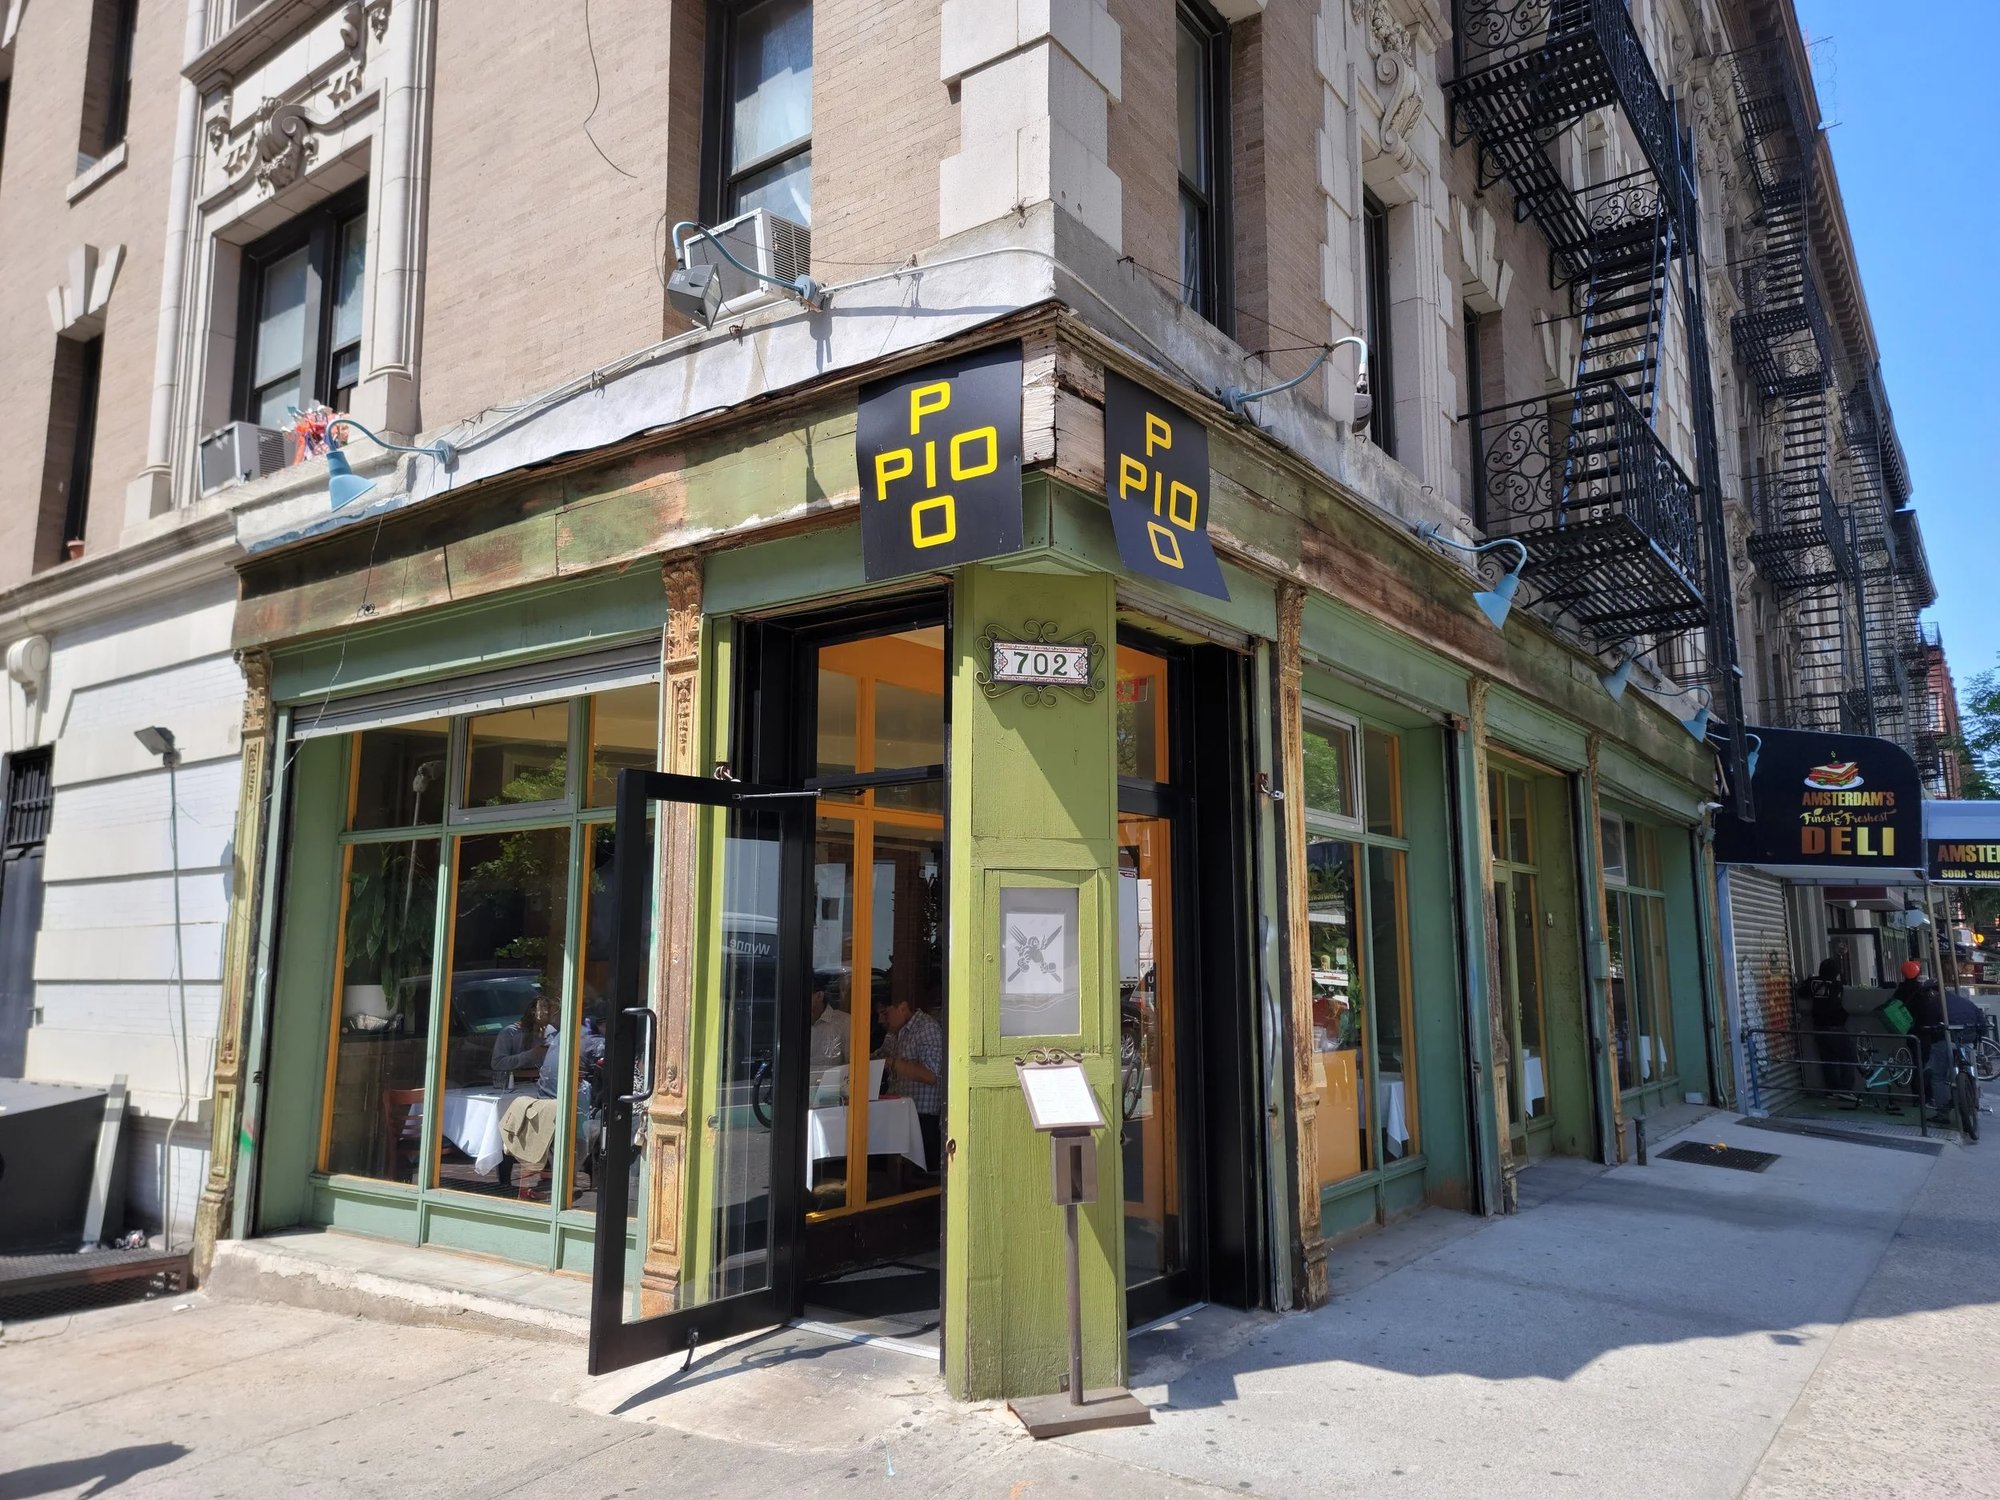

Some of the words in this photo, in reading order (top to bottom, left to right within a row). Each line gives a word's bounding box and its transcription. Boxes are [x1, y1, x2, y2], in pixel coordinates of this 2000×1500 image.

[875, 426, 998, 501] PIO
[1119, 453, 1198, 532] PIO
[1013, 651, 1068, 676] 702
[1802, 791, 1895, 806] AMSTERDAM'S
[1800, 808, 1844, 825] Finest
[1841, 809, 1897, 825] Freshest
[1801, 826, 1895, 856] DELI
[1941, 869, 1967, 879] SODA
